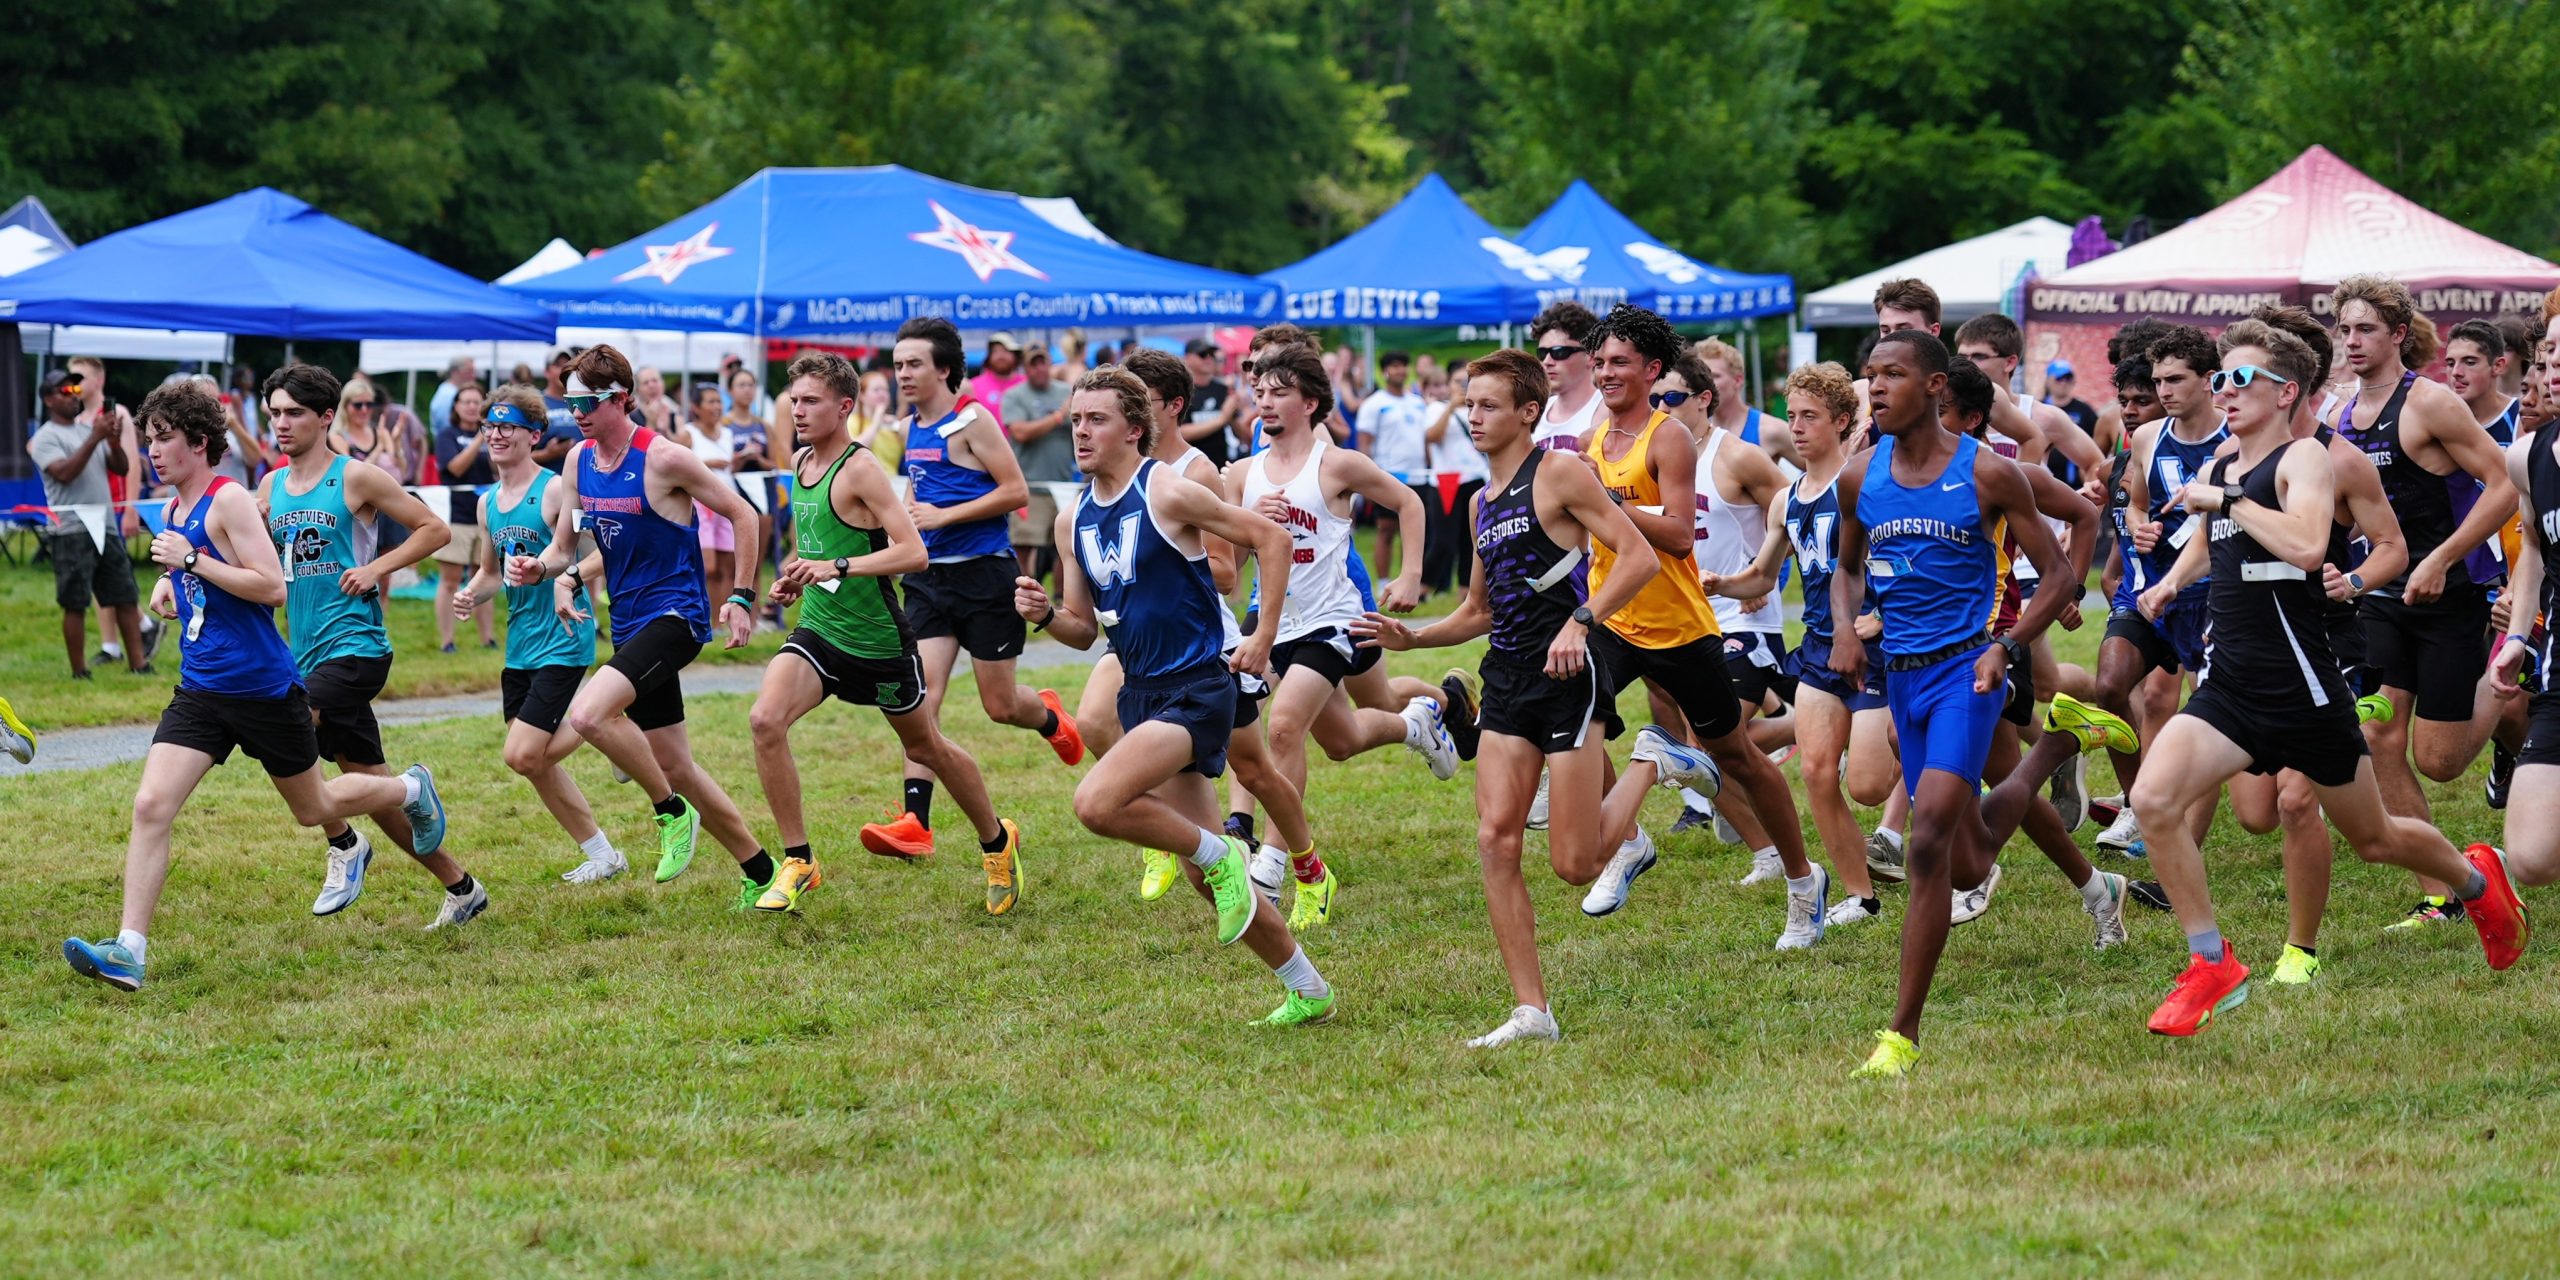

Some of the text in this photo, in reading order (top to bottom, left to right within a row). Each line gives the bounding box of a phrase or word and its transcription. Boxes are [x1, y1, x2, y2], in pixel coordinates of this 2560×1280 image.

[807, 296, 902, 324] McDowell
[904, 294, 954, 319] Titan
[956, 293, 1014, 320] Cross
[1014, 292, 1092, 322] Country
[1104, 291, 1160, 316] Track
[1161, 291, 1198, 315] and
[1198, 290, 1246, 315] Field
[1286, 286, 1441, 320] LUE DEVILS
[2032, 288, 2120, 313] OFFICIAL
[2124, 290, 2192, 315] EVENT
[2422, 289, 2496, 313] EVENT
[594, 496, 643, 515] HENDERSON
[791, 502, 823, 553] K
[1491, 516, 1530, 542] STOKES
[1868, 518, 1970, 545] MOORESVILLE
[1079, 510, 1143, 590] W
[1785, 511, 1837, 576] W
[296, 561, 339, 577] COUNTRY
[875, 682, 901, 705] K
